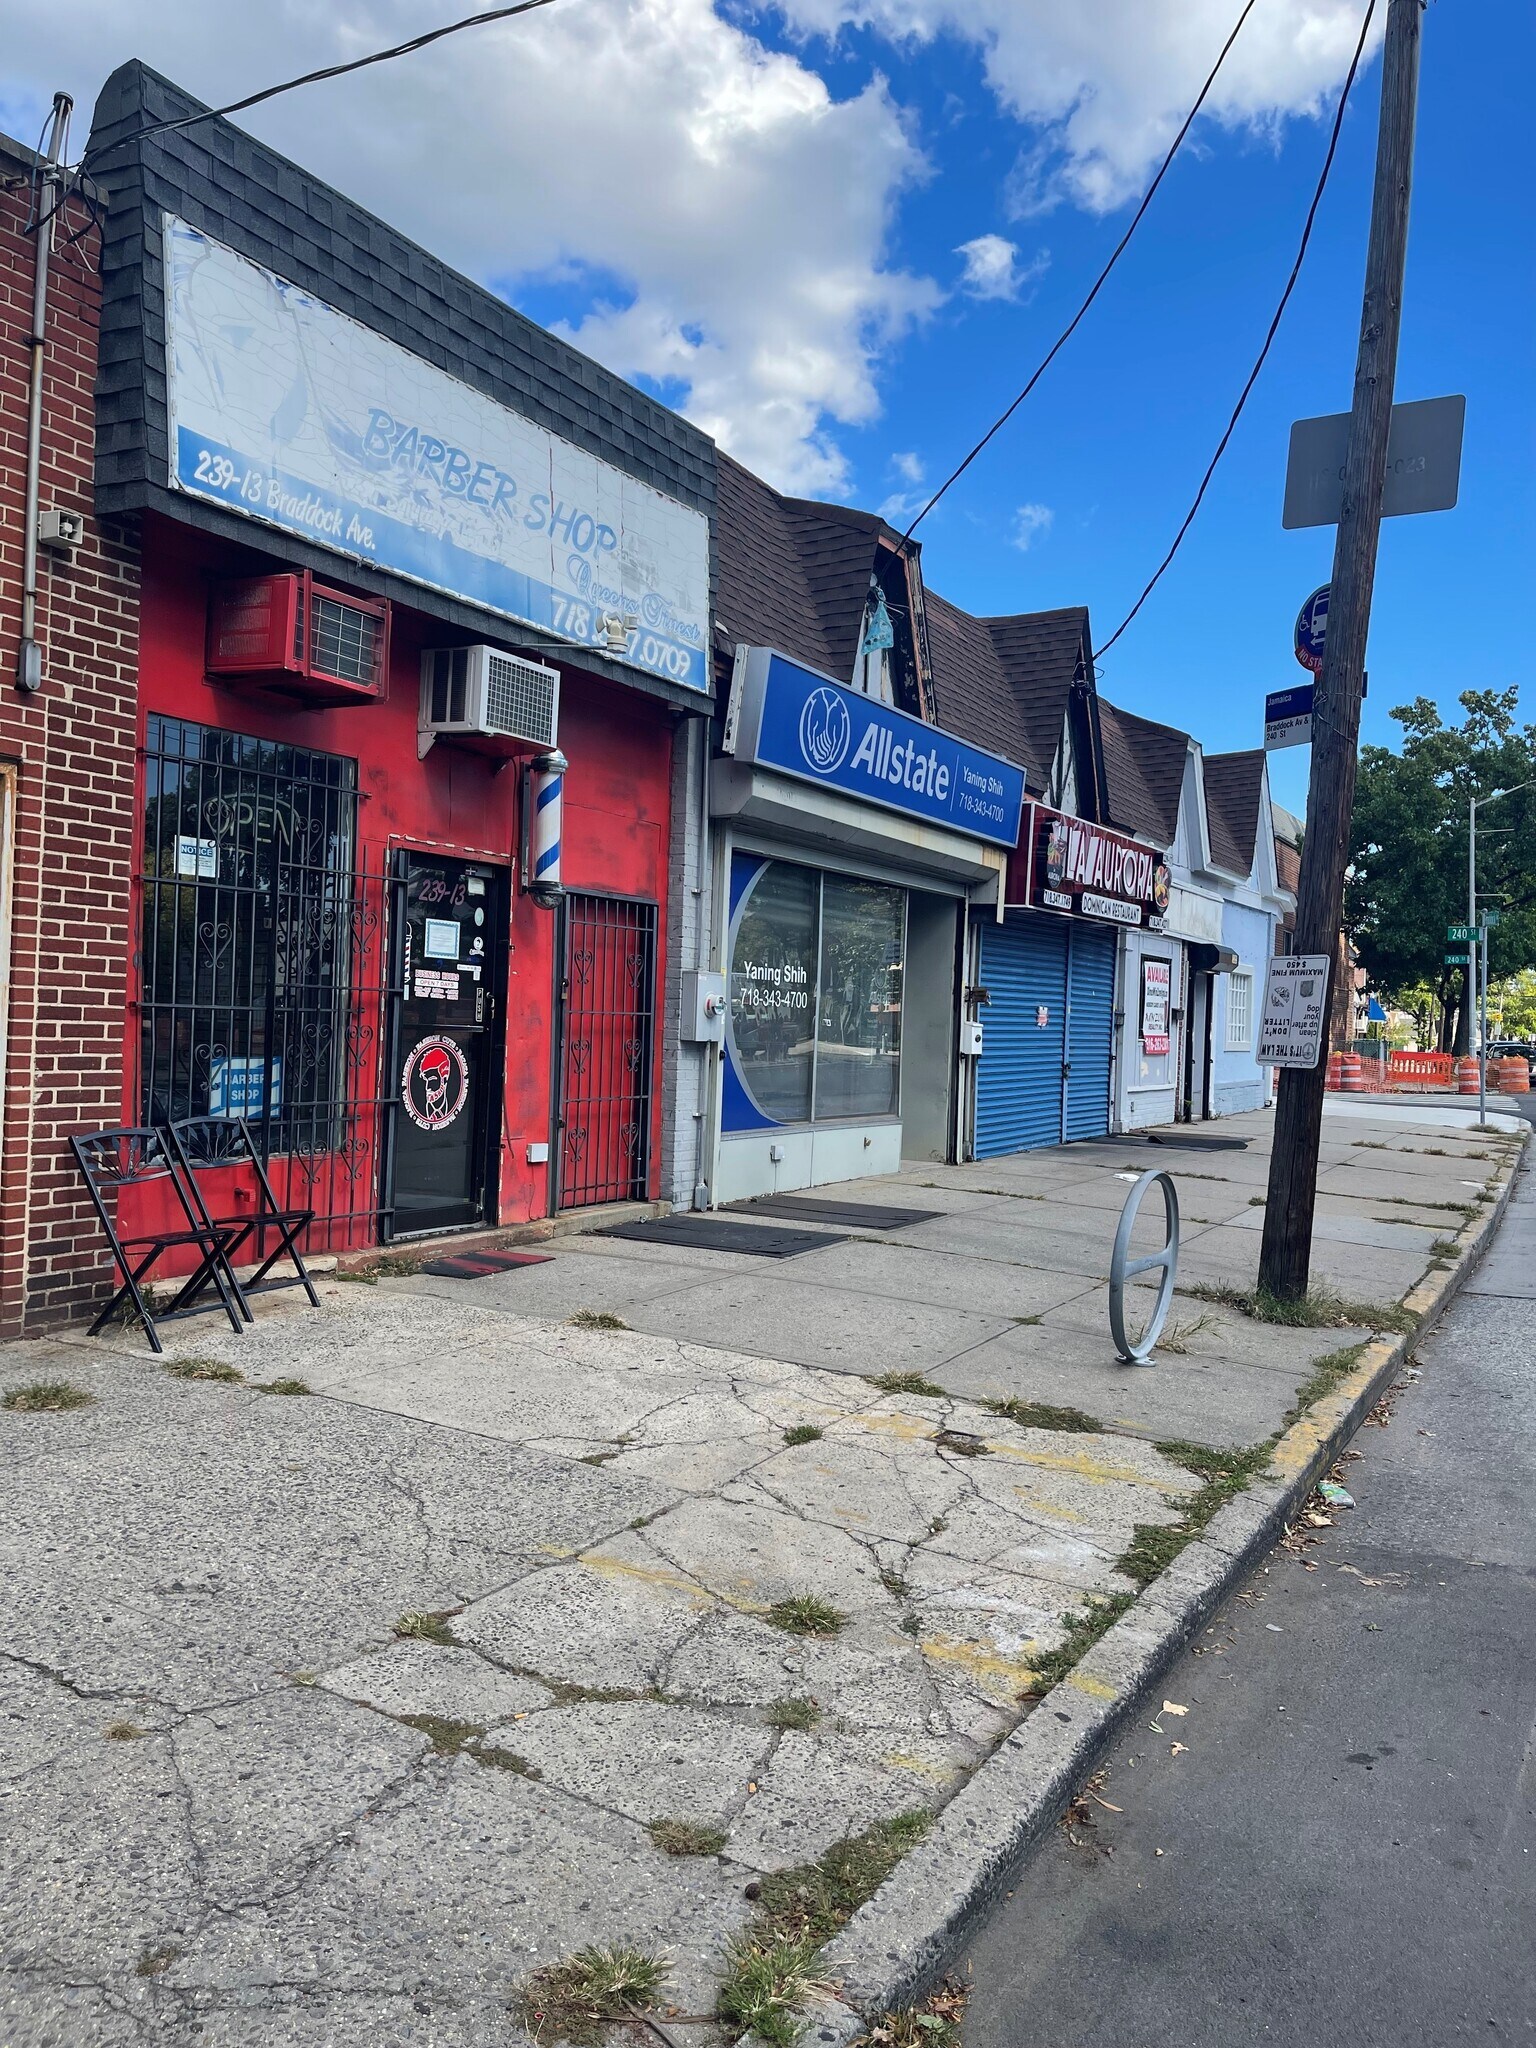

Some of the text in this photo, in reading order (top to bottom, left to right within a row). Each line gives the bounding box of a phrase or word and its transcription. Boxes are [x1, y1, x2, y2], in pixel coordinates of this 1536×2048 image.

[363, 408, 518, 518] BARBER
[523, 493, 617, 559] SHOP
[194, 450, 262, 502] 239-13
[267, 479, 343, 537] Braddock
[346, 514, 376, 550] Ave.
[567, 554, 701, 642] Queens Finest
[552, 594, 691, 677] 718.7.0709
[1297, 648, 1308, 663] NO
[1268, 694, 1292, 706] Jamaica
[1266, 715, 1309, 732] Braddock Av &
[1266, 730, 1287, 741] 240 St
[850, 722, 949, 801] Allstate
[963, 765, 1003, 796] Yaning Shih
[959, 792, 1004, 823] 718-343-4700
[1067, 826, 1153, 902] LA AURORA
[418, 879, 466, 906] 239-13
[1084, 893, 1140, 923] DOMINICAN RESTAURANT
[1452, 928, 1467, 939] 240
[1447, 956, 1460, 964] 240
[415, 969, 440, 979] BUSINESS
[743, 961, 807, 986] Yaning Shih
[1289, 968, 1323, 976] MAXIMUM
[741, 987, 808, 1009] 718-343-4700
[1306, 1004, 1320, 1013] dog
[1264, 1018, 1290, 1026] LITTER
[1303, 1012, 1320, 1021] your
[1264, 1027, 1287, 1037] DON'T
[1292, 1020, 1318, 1030] up after
[1298, 1029, 1317, 1037] clean
[1261, 1043, 1302, 1057] IT'S THE LAW
[231, 1089, 260, 1101] SHOP
